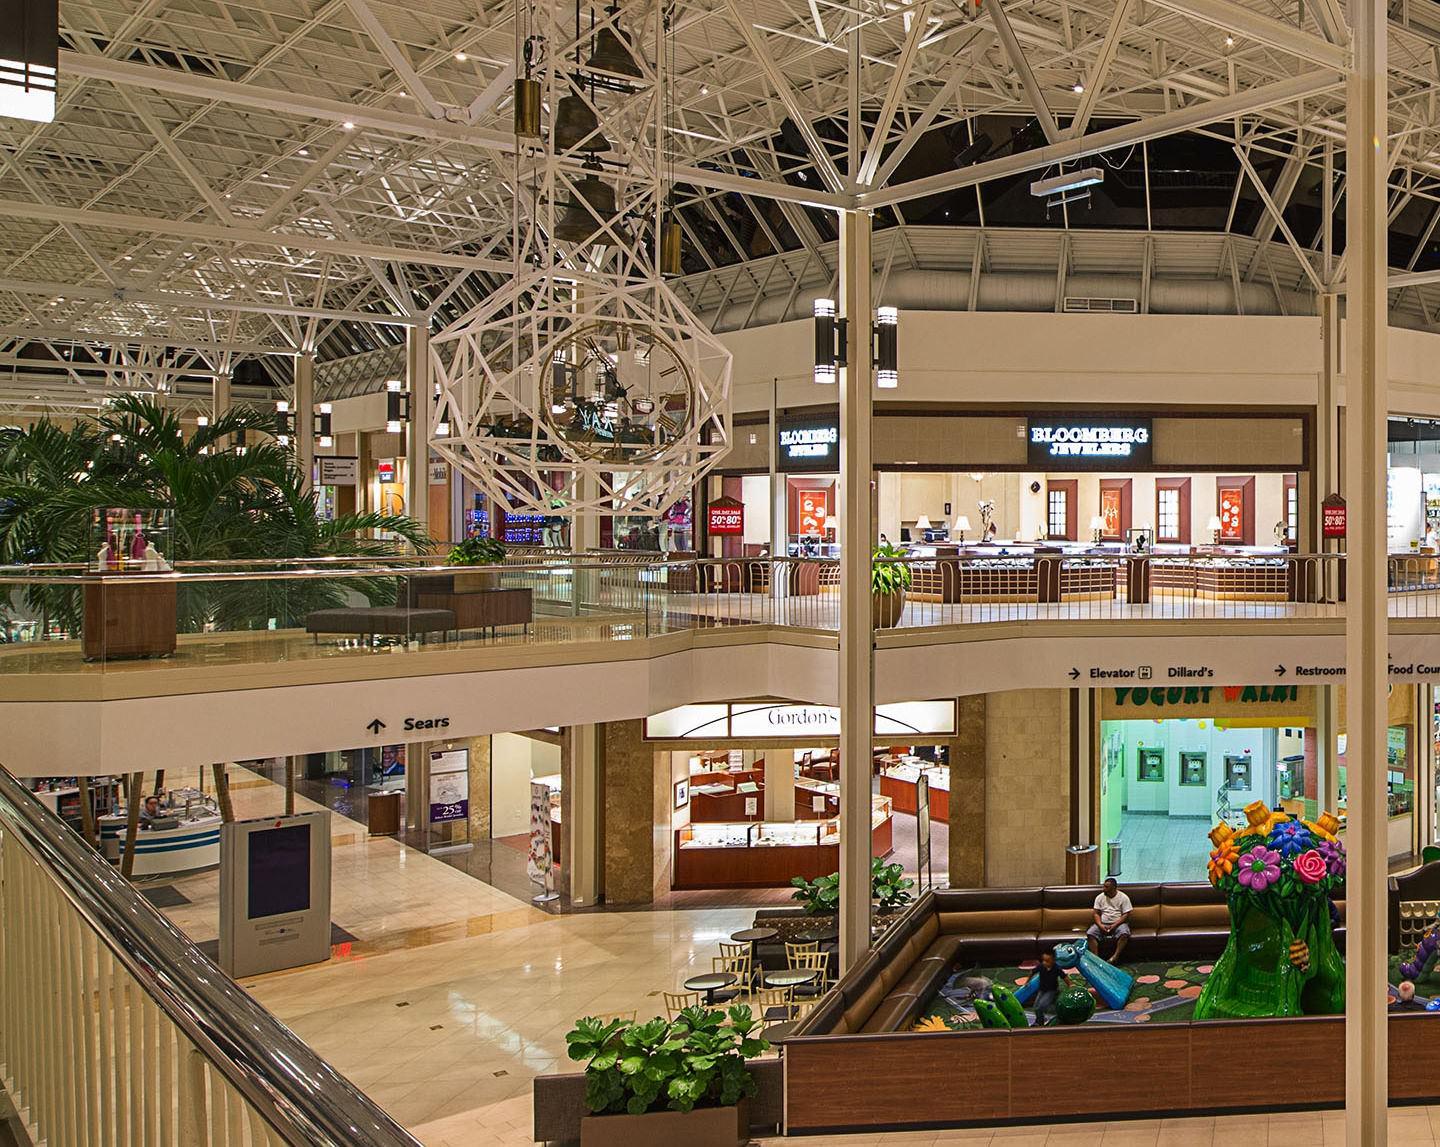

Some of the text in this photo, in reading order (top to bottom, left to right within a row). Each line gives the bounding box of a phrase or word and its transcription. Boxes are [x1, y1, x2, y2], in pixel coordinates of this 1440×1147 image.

[780, 427, 838, 446] BLOOMBERG
[1031, 427, 1148, 442] BLOOMBERG
[1049, 442, 1131, 456] JEWELERS
[1090, 667, 1213, 678] Elevator Dillard's
[1388, 664, 1413, 675] Food
[1114, 687, 1214, 707] YOGURT
[768, 708, 837, 724] Gordon's
[404, 717, 449, 730] Sears
